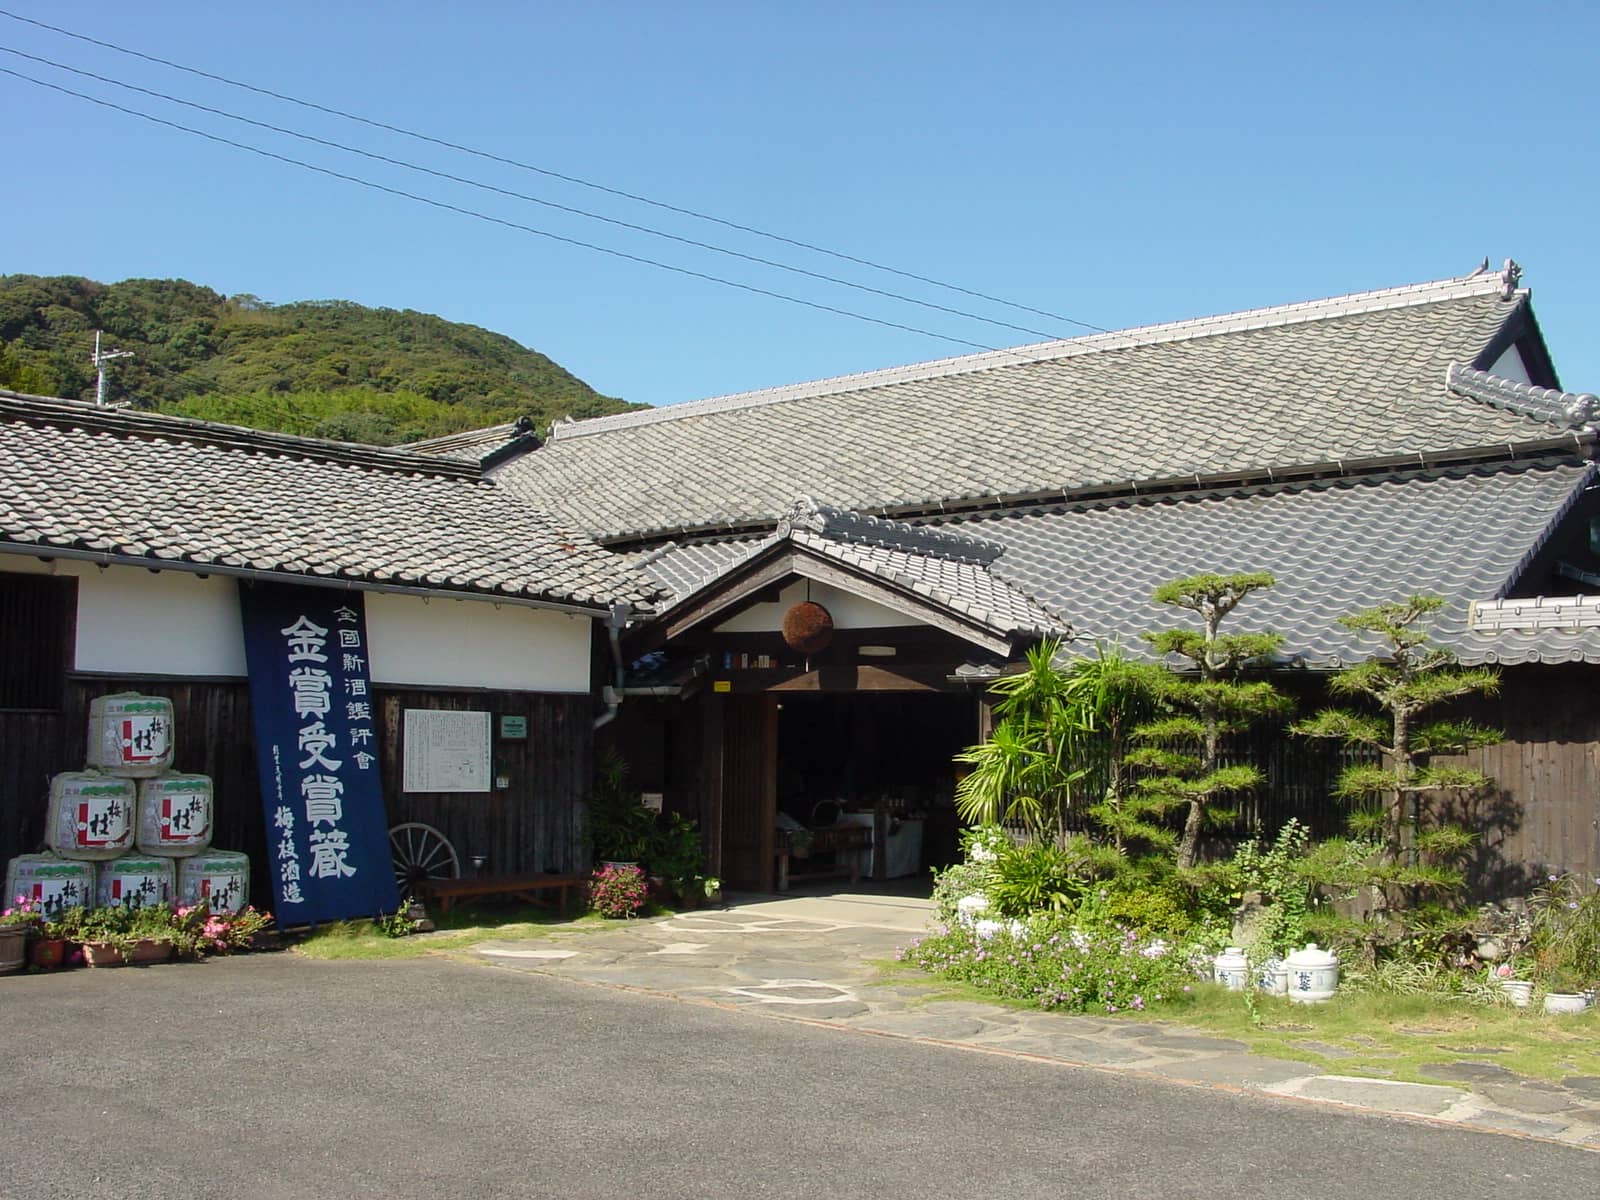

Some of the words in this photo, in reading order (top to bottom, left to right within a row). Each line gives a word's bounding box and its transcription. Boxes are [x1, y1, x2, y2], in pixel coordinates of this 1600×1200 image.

[280, 615, 357, 879] 金賞受賞蔵
